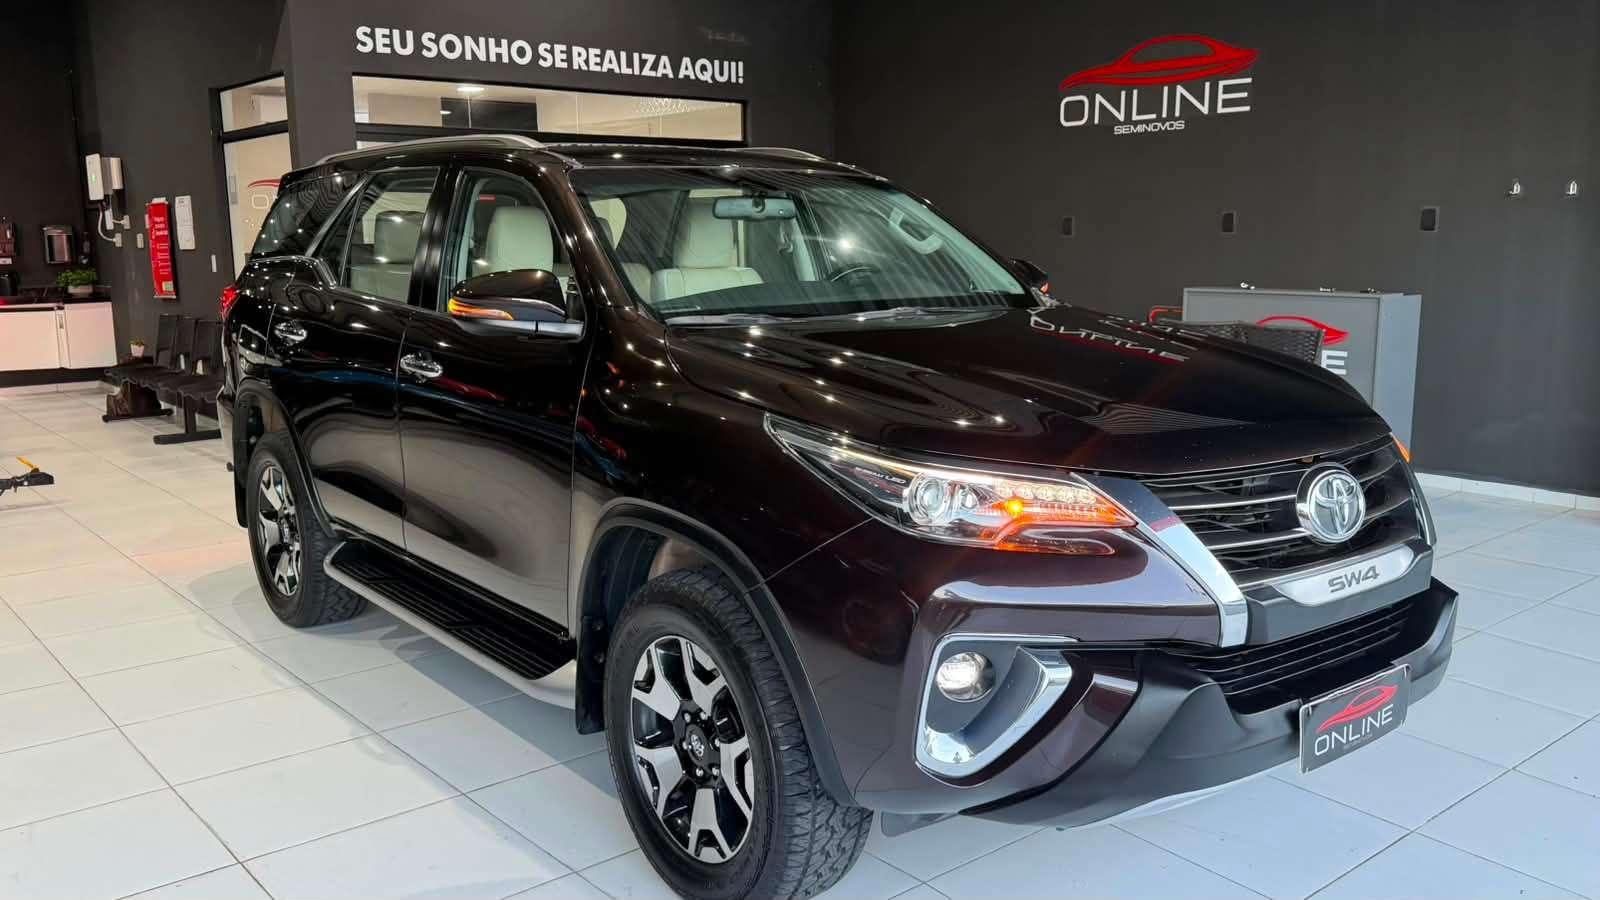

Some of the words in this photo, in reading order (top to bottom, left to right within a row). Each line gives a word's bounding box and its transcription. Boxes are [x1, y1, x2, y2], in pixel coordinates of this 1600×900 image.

[356, 26, 414, 56] SEU
[421, 33, 532, 65] SONHO
[538, 43, 568, 69] SE
[572, 45, 674, 79] REALIZA
[679, 56, 744, 84] AQUI!
[1060, 77, 1253, 127] ONLINE
[1113, 120, 1185, 135] SEMINOVOS
[1328, 565, 1380, 593] SW4
[1315, 703, 1394, 756] ONLINE
